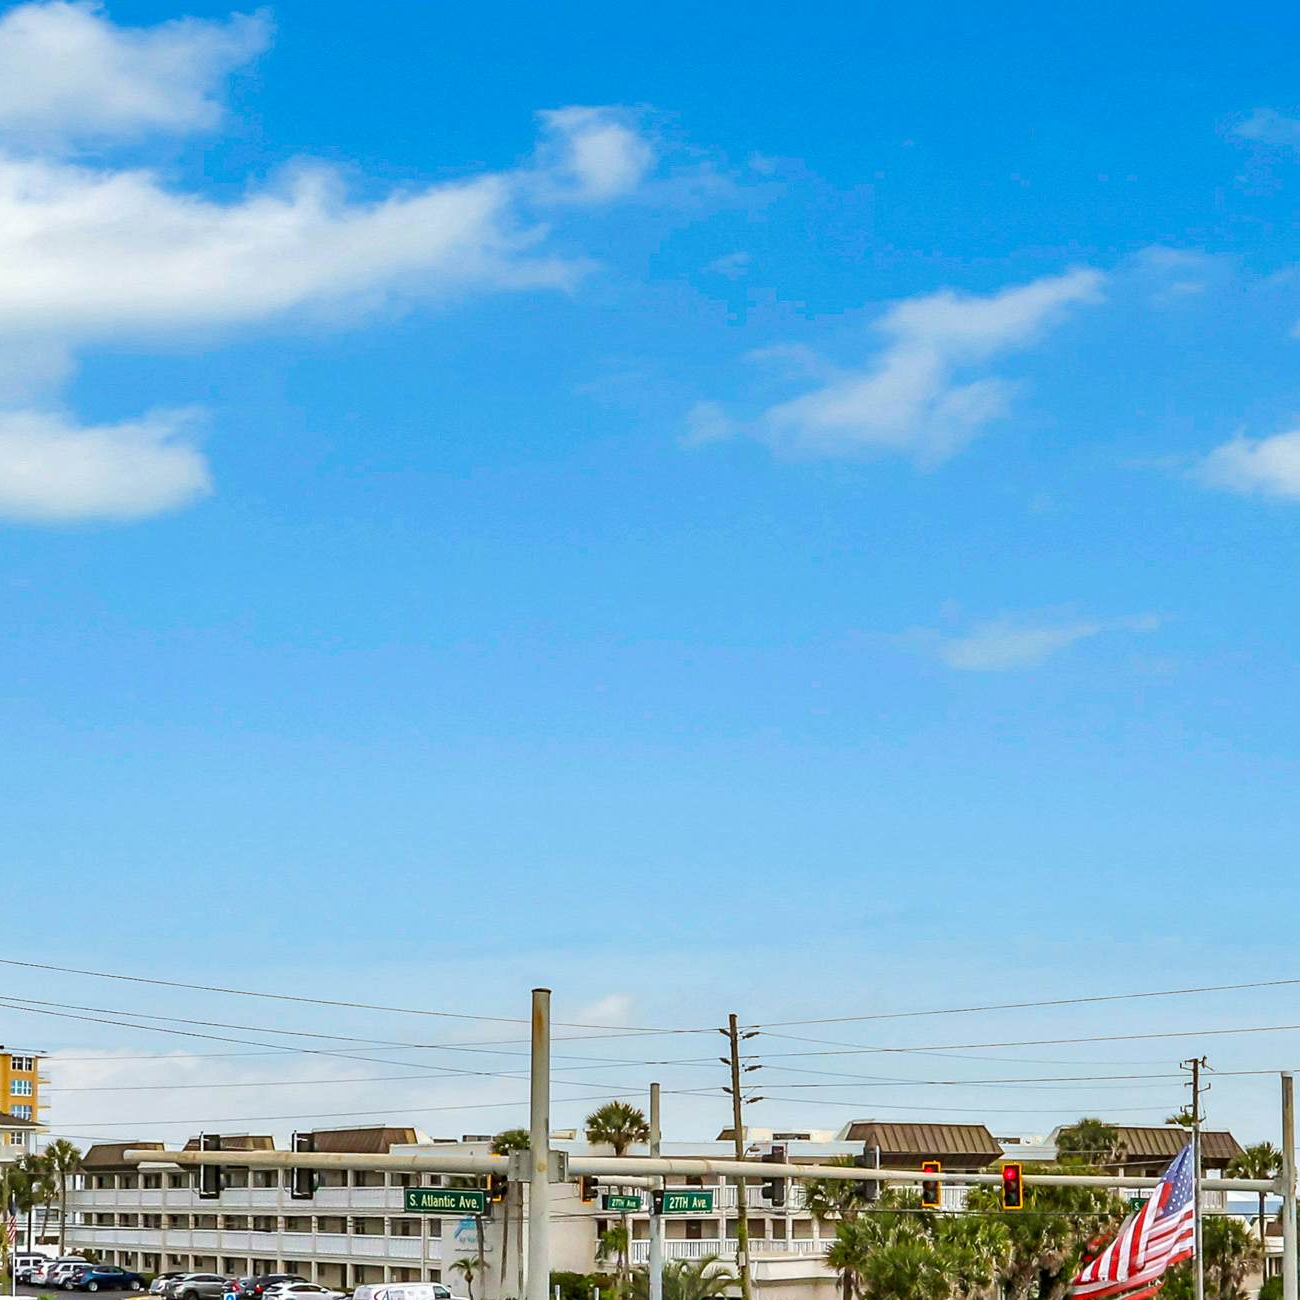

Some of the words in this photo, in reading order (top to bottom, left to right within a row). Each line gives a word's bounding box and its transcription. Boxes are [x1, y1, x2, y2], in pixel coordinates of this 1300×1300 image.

[409, 1193, 418, 1206] S.
[421, 1194, 455, 1208] Atlantic
[459, 1196, 479, 1209] Ave.
[669, 1197, 688, 1209] 27TH
